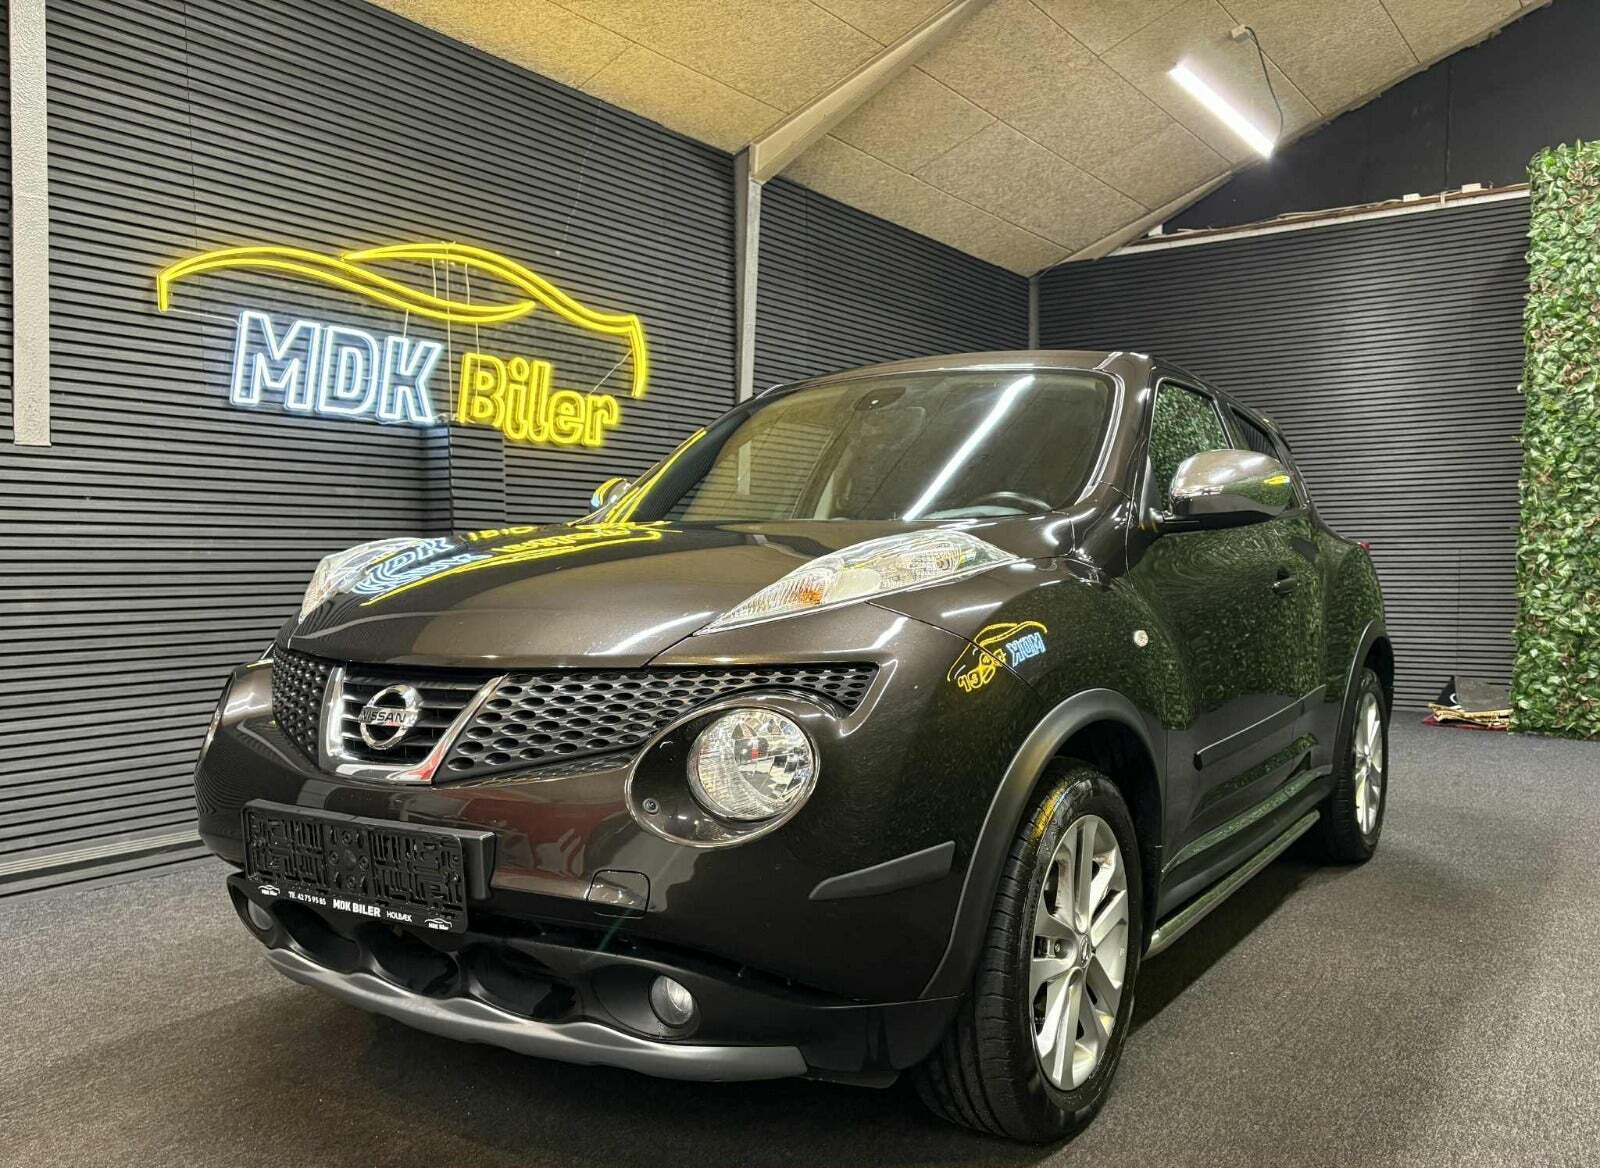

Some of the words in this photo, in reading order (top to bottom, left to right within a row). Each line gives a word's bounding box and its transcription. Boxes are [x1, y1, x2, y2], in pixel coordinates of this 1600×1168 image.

[229, 310, 443, 425] MDK
[458, 352, 620, 447] Biler
[361, 711, 407, 723] NISSAN
[333, 898, 351, 912] MDK
[352, 902, 382, 918] BILER
